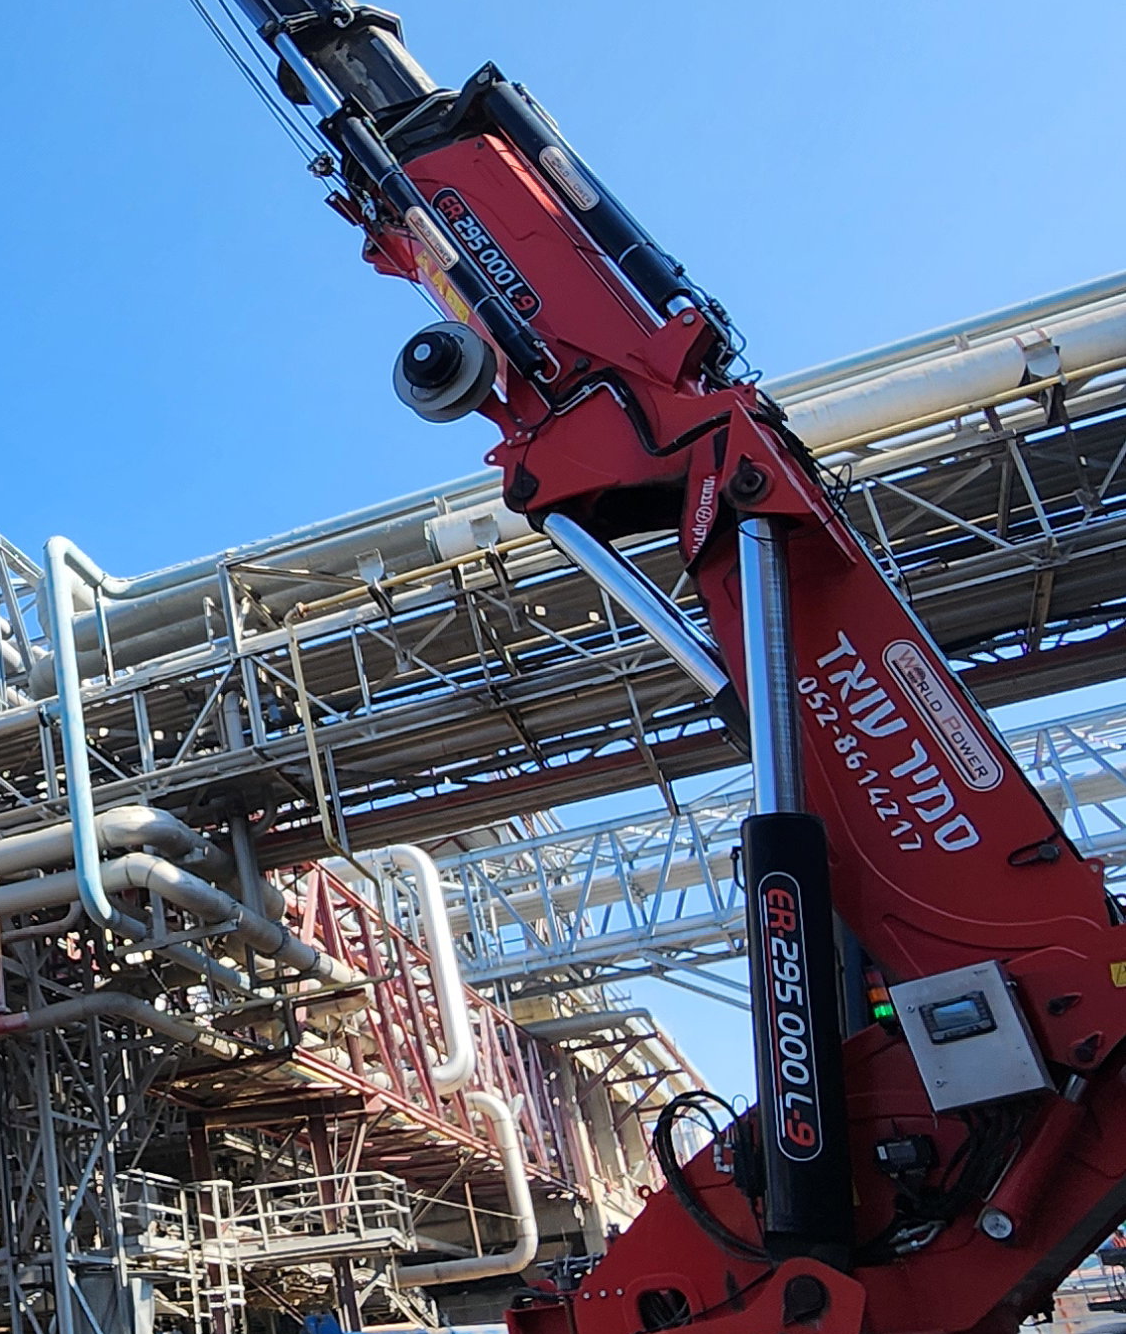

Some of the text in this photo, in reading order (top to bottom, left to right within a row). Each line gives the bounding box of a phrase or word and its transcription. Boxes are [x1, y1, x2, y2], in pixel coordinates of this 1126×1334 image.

[438, 195, 536, 312] ER-295 000 L-9
[797, 676, 922, 851] 052-8614217
[816, 630, 980, 852] סמיר עואד
[898, 648, 989, 779] WORLD POWER
[767, 887, 817, 1148] ER-295 000 L-9
